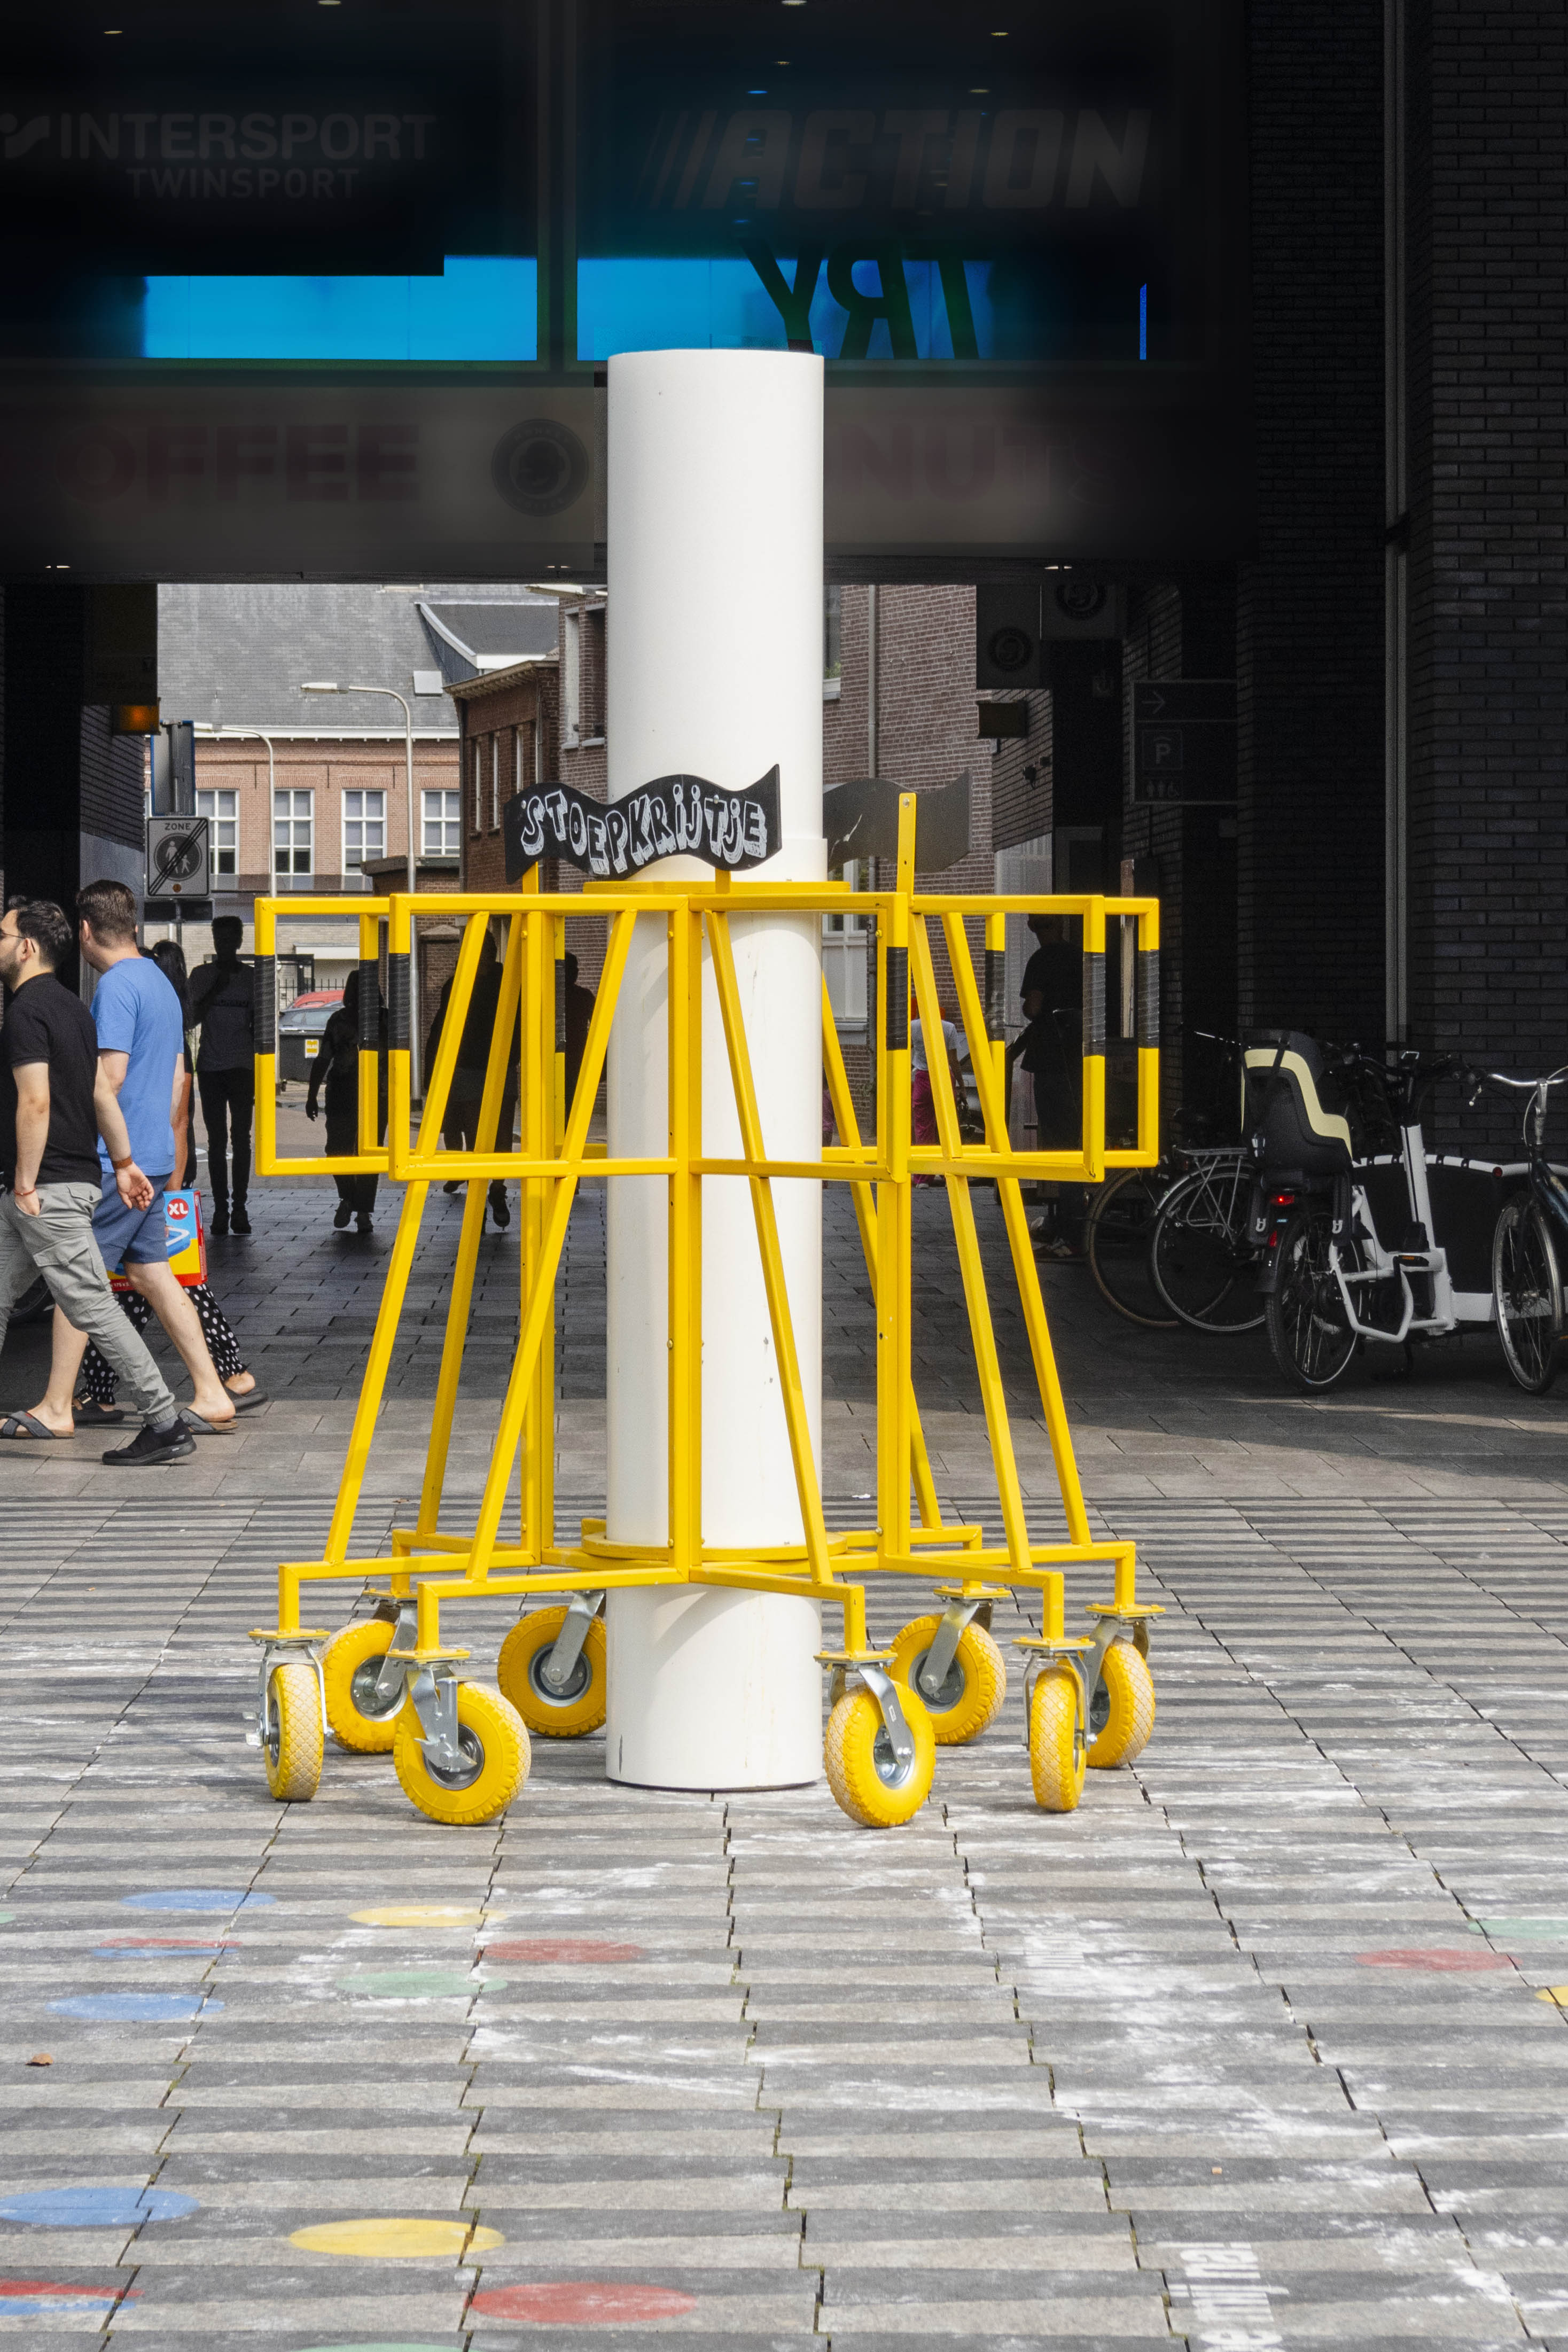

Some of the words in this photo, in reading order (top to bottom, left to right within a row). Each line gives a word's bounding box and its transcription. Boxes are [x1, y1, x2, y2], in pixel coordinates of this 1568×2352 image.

[61, 113, 436, 160] INTERSPORT
[701, 108, 1152, 209] ACTION
[126, 168, 360, 199] TWINSPORT
[165, 823, 191, 831] ZONE
[168, 1203, 189, 1216] XL
